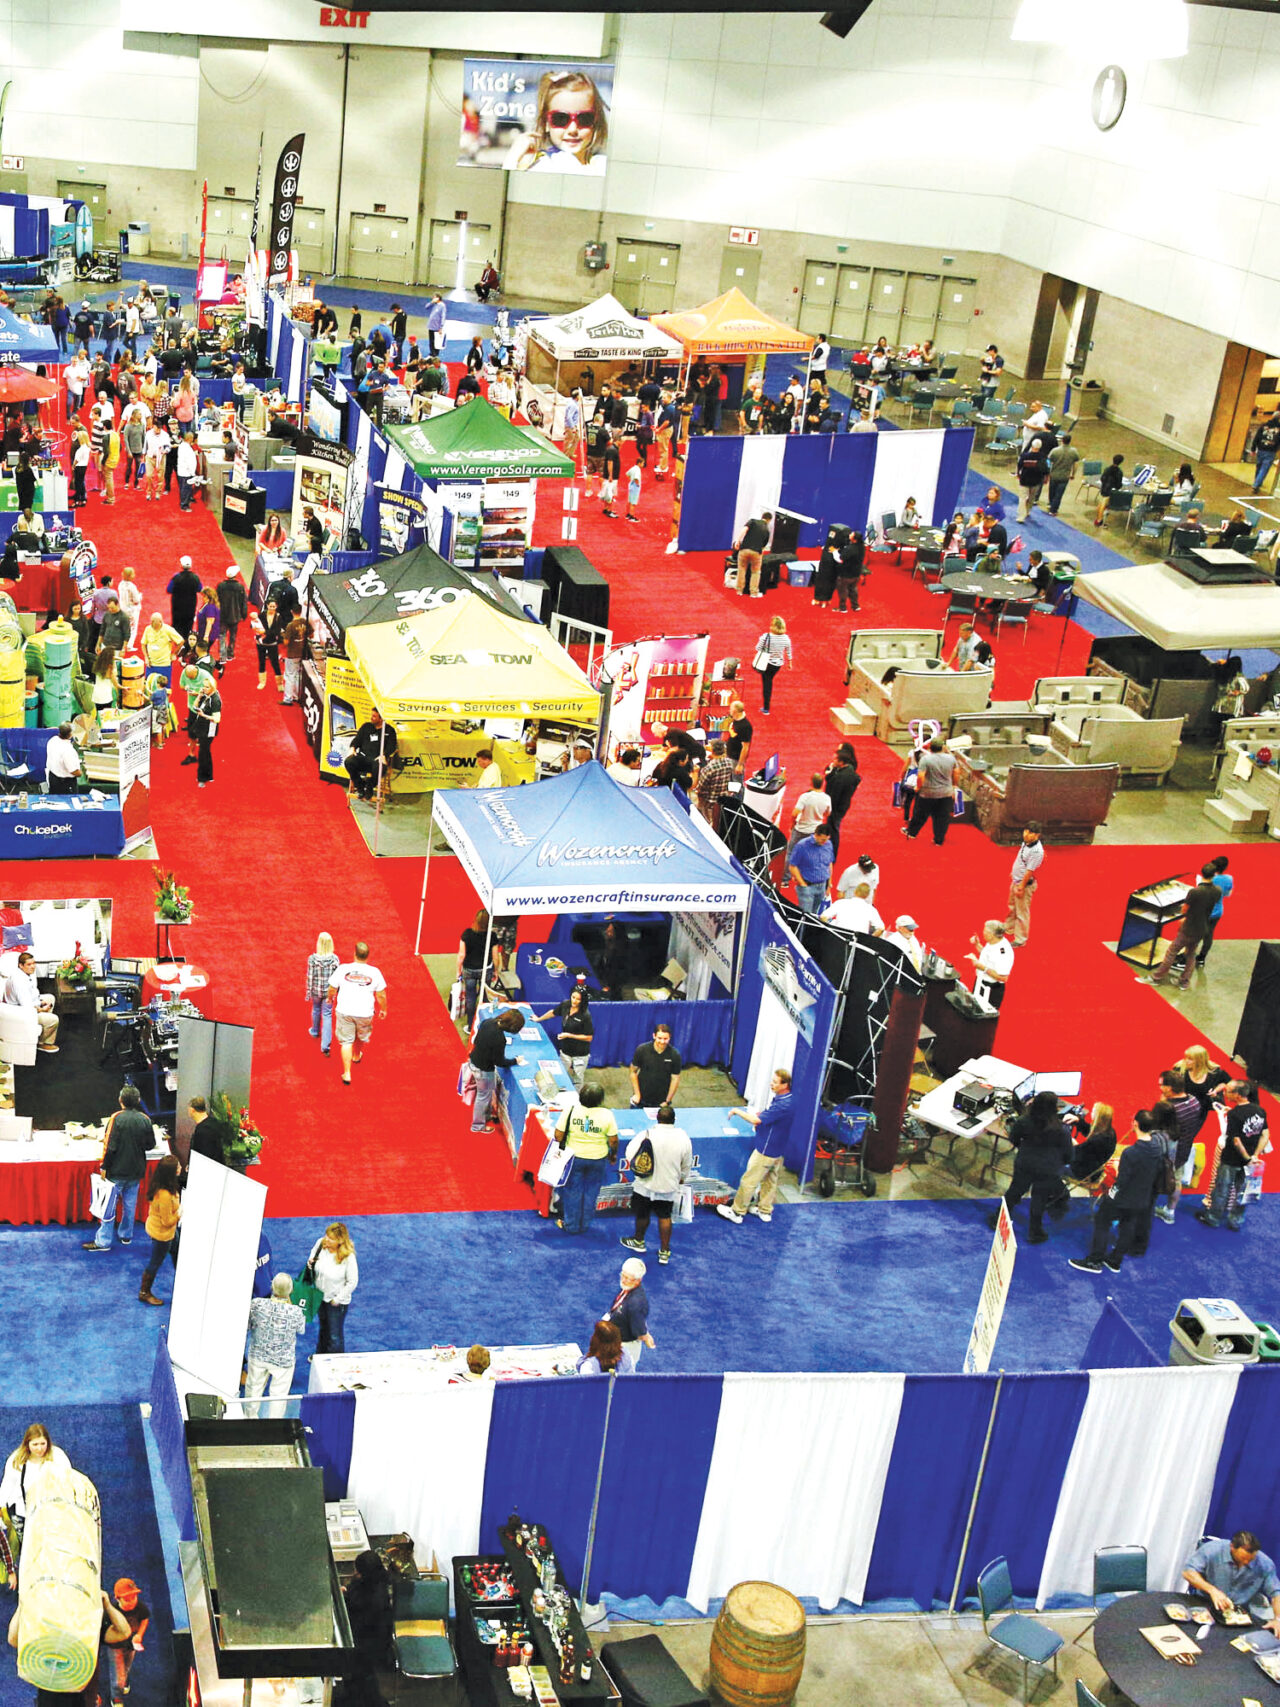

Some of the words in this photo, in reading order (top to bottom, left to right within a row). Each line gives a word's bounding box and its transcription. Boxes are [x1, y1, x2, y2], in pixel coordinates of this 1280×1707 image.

[320, 7, 371, 28] EXIT
[472, 71, 526, 94] Kid's
[480, 96, 537, 117] Zone
[601, 348, 619, 356] TASTE
[620, 348, 626, 356] IS
[627, 348, 642, 356] KING
[311, 449, 334, 459] Kitchen
[430, 464, 562, 476] www.VerengoSolar.com
[383, 491, 403, 504] SHOW
[429, 654, 468, 665] SEA
[488, 652, 533, 665] TOW
[398, 703, 447, 714] Savings
[464, 702, 516, 712] Services
[533, 702, 584, 713] Security
[442, 756, 477, 768] TOW
[14, 823, 73, 835] ChoiceDek
[536, 836, 678, 868] Wozencraft
[506, 890, 737, 907] www.wozencraftinsurance.com
